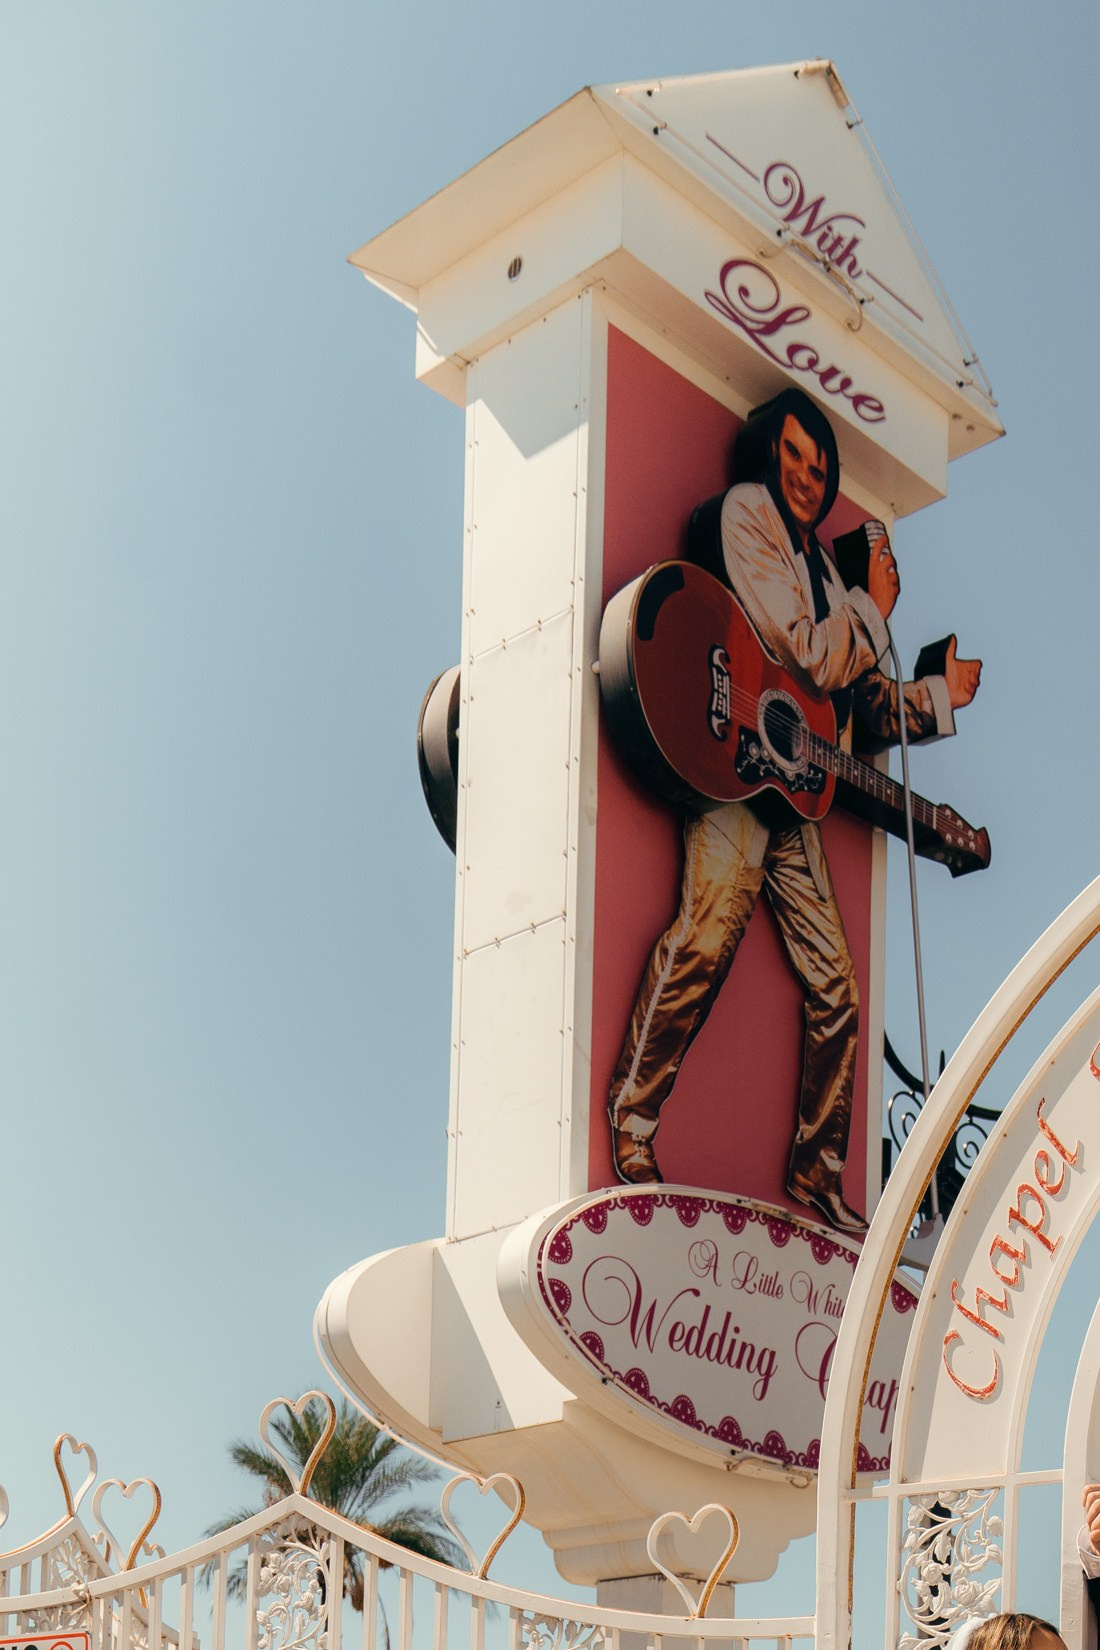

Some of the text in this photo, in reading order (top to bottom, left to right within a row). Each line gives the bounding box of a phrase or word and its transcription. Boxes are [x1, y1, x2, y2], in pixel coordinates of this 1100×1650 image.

[763, 162, 867, 280] With
[704, 259, 887, 423] Love
[687, 1238, 723, 1288] A
[731, 1251, 784, 1300] Little
[942, 1097, 1081, 1400] Chapel
[582, 1255, 779, 1402] Wedding
